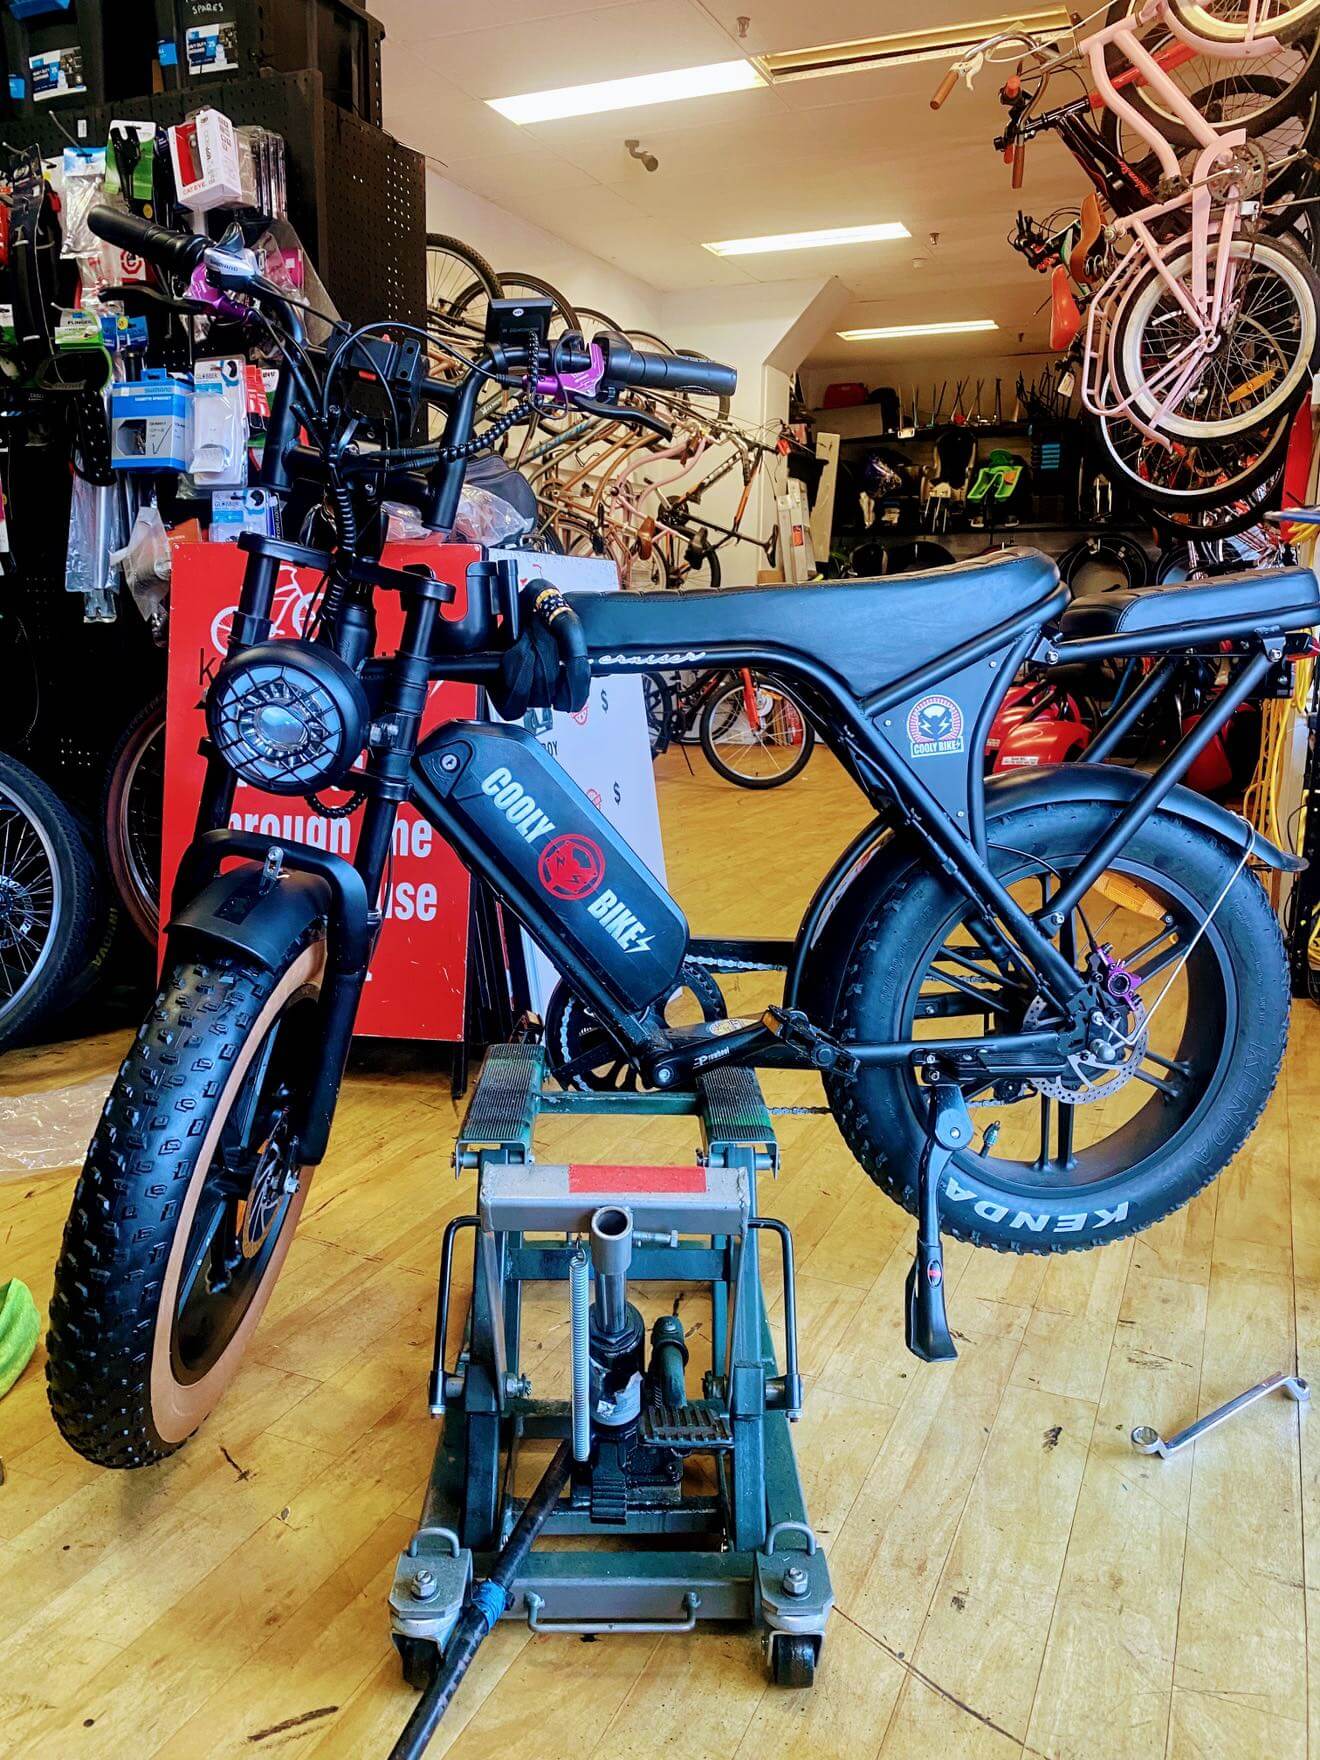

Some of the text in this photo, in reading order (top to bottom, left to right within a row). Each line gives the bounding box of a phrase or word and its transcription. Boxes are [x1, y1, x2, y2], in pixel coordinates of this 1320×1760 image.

[192, 3, 224, 15] SPARES
[914, 742, 937, 754] COOLY
[481, 767, 556, 844] COOLY
[613, 781, 621, 806] $
[1191, 1041, 1268, 1166] KENDA
[943, 1176, 1132, 1234] KENDA
